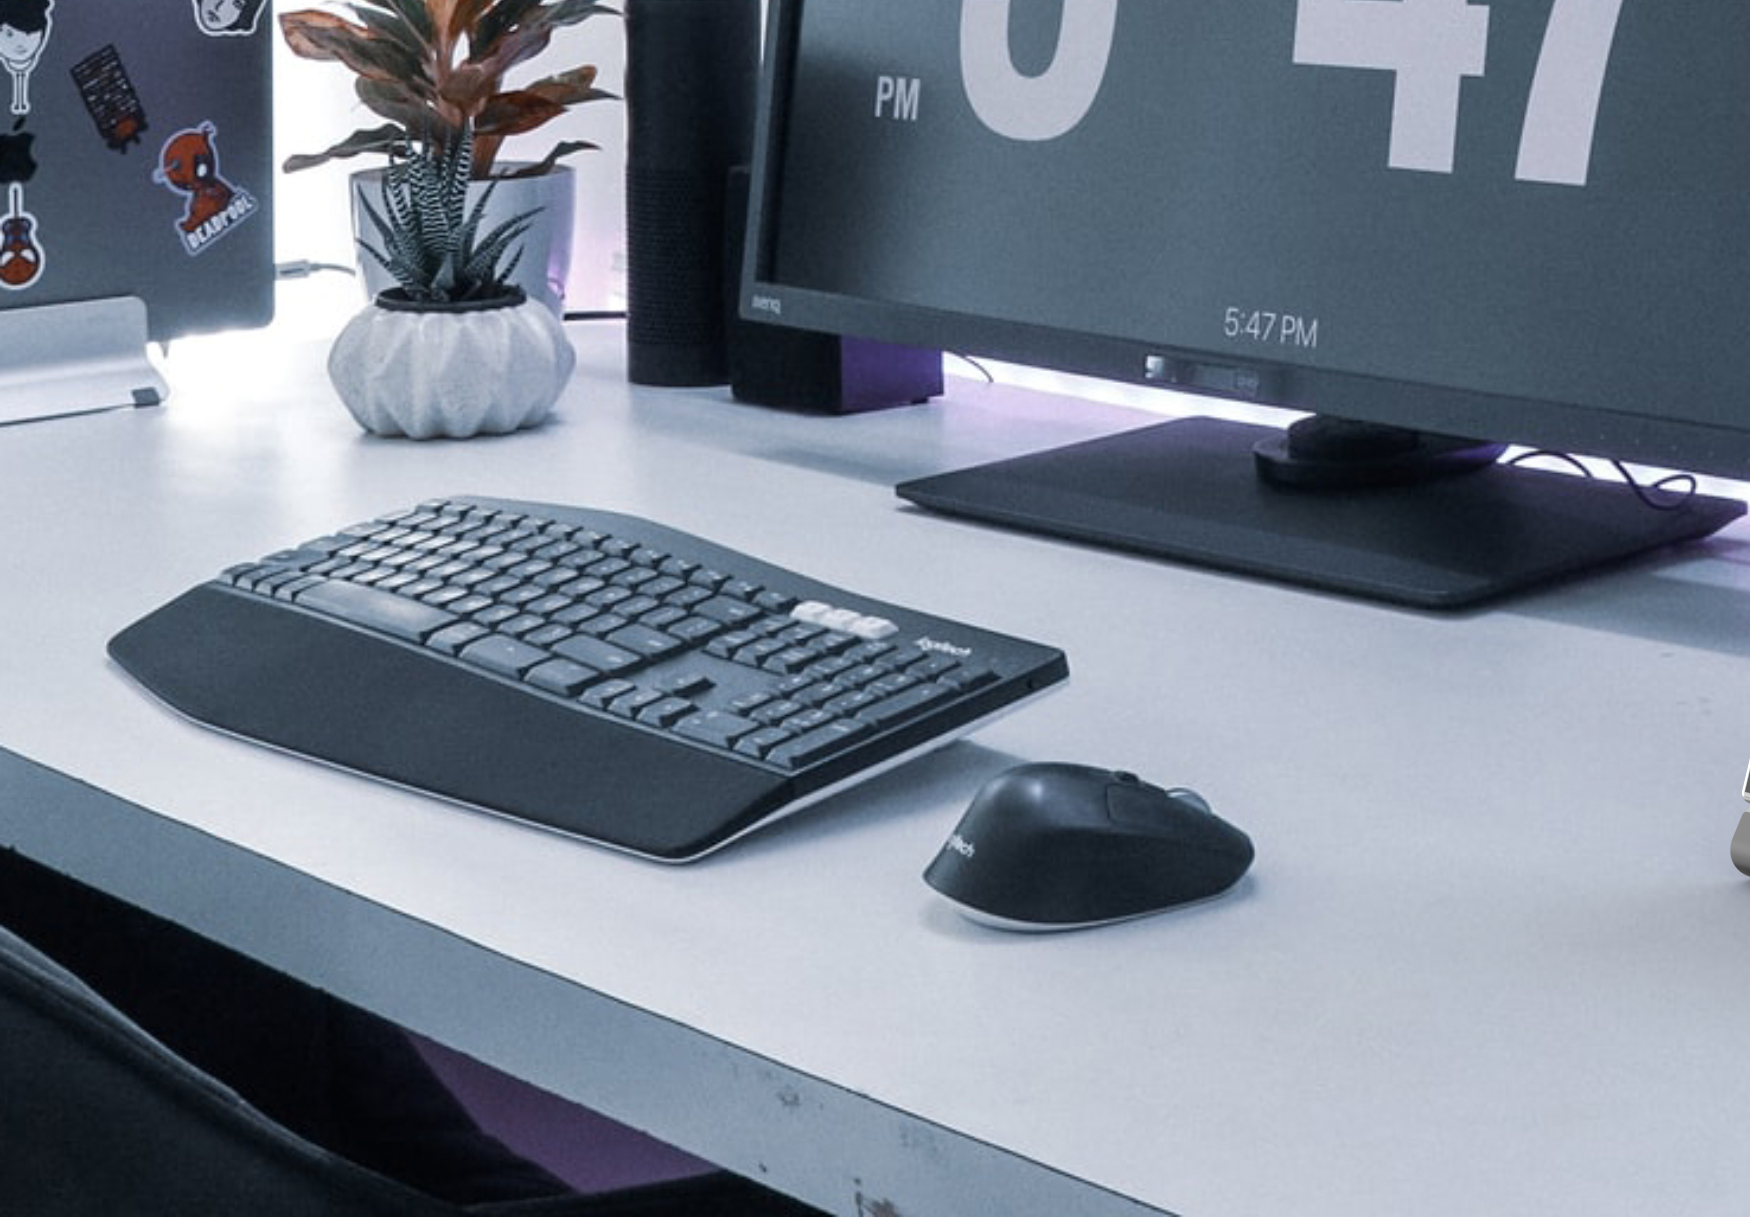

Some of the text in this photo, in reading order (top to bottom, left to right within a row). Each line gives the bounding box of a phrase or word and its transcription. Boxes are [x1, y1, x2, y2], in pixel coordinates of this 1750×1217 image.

[875, 75, 920, 122] PM
[187, 195, 253, 249] DEADPOOL
[1224, 306, 1318, 348] 5:47 PM
